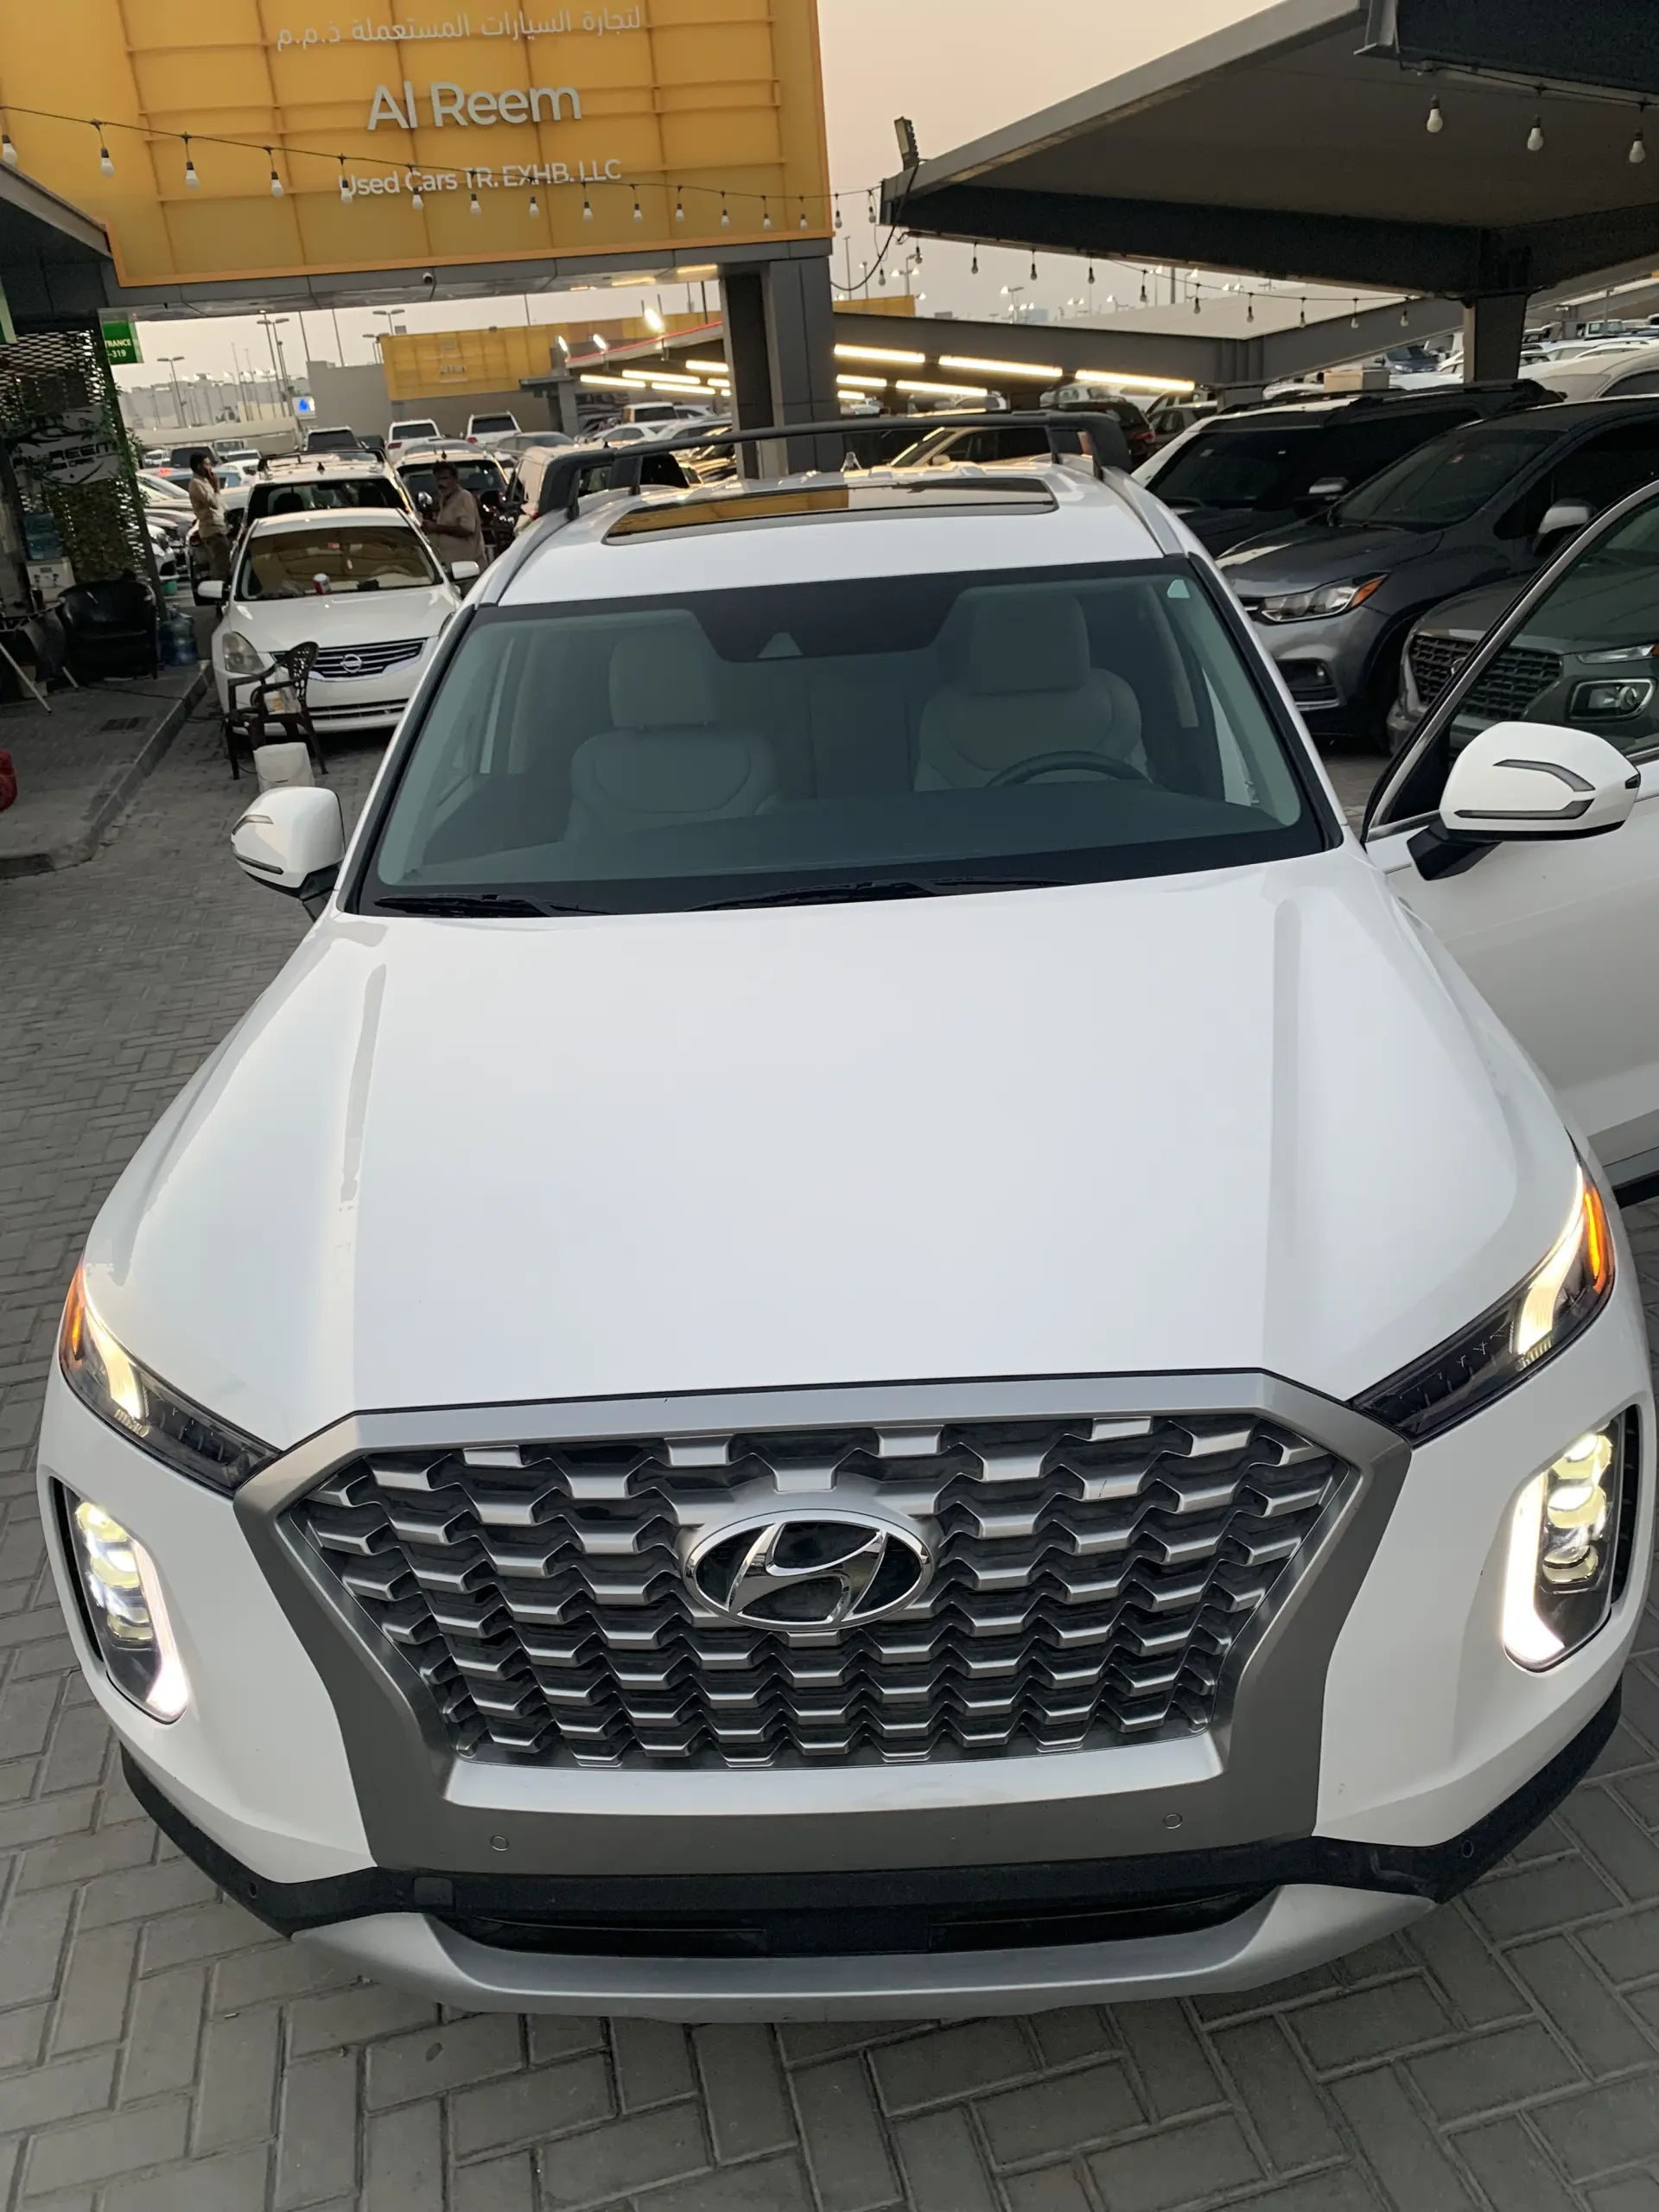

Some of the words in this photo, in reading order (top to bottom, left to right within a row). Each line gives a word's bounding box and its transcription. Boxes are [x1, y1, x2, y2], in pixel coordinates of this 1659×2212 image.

[352, 12, 469, 41] المستعملة
[480, 9, 571, 41] السيارات
[582, 5, 640, 36] لتجارة
[367, 80, 418, 130] Al
[430, 81, 582, 127] Reem
[338, 170, 400, 197] Used
[404, 169, 458, 192] Cars
[464, 166, 499, 189] TR.
[578, 158, 622, 183] LLC
